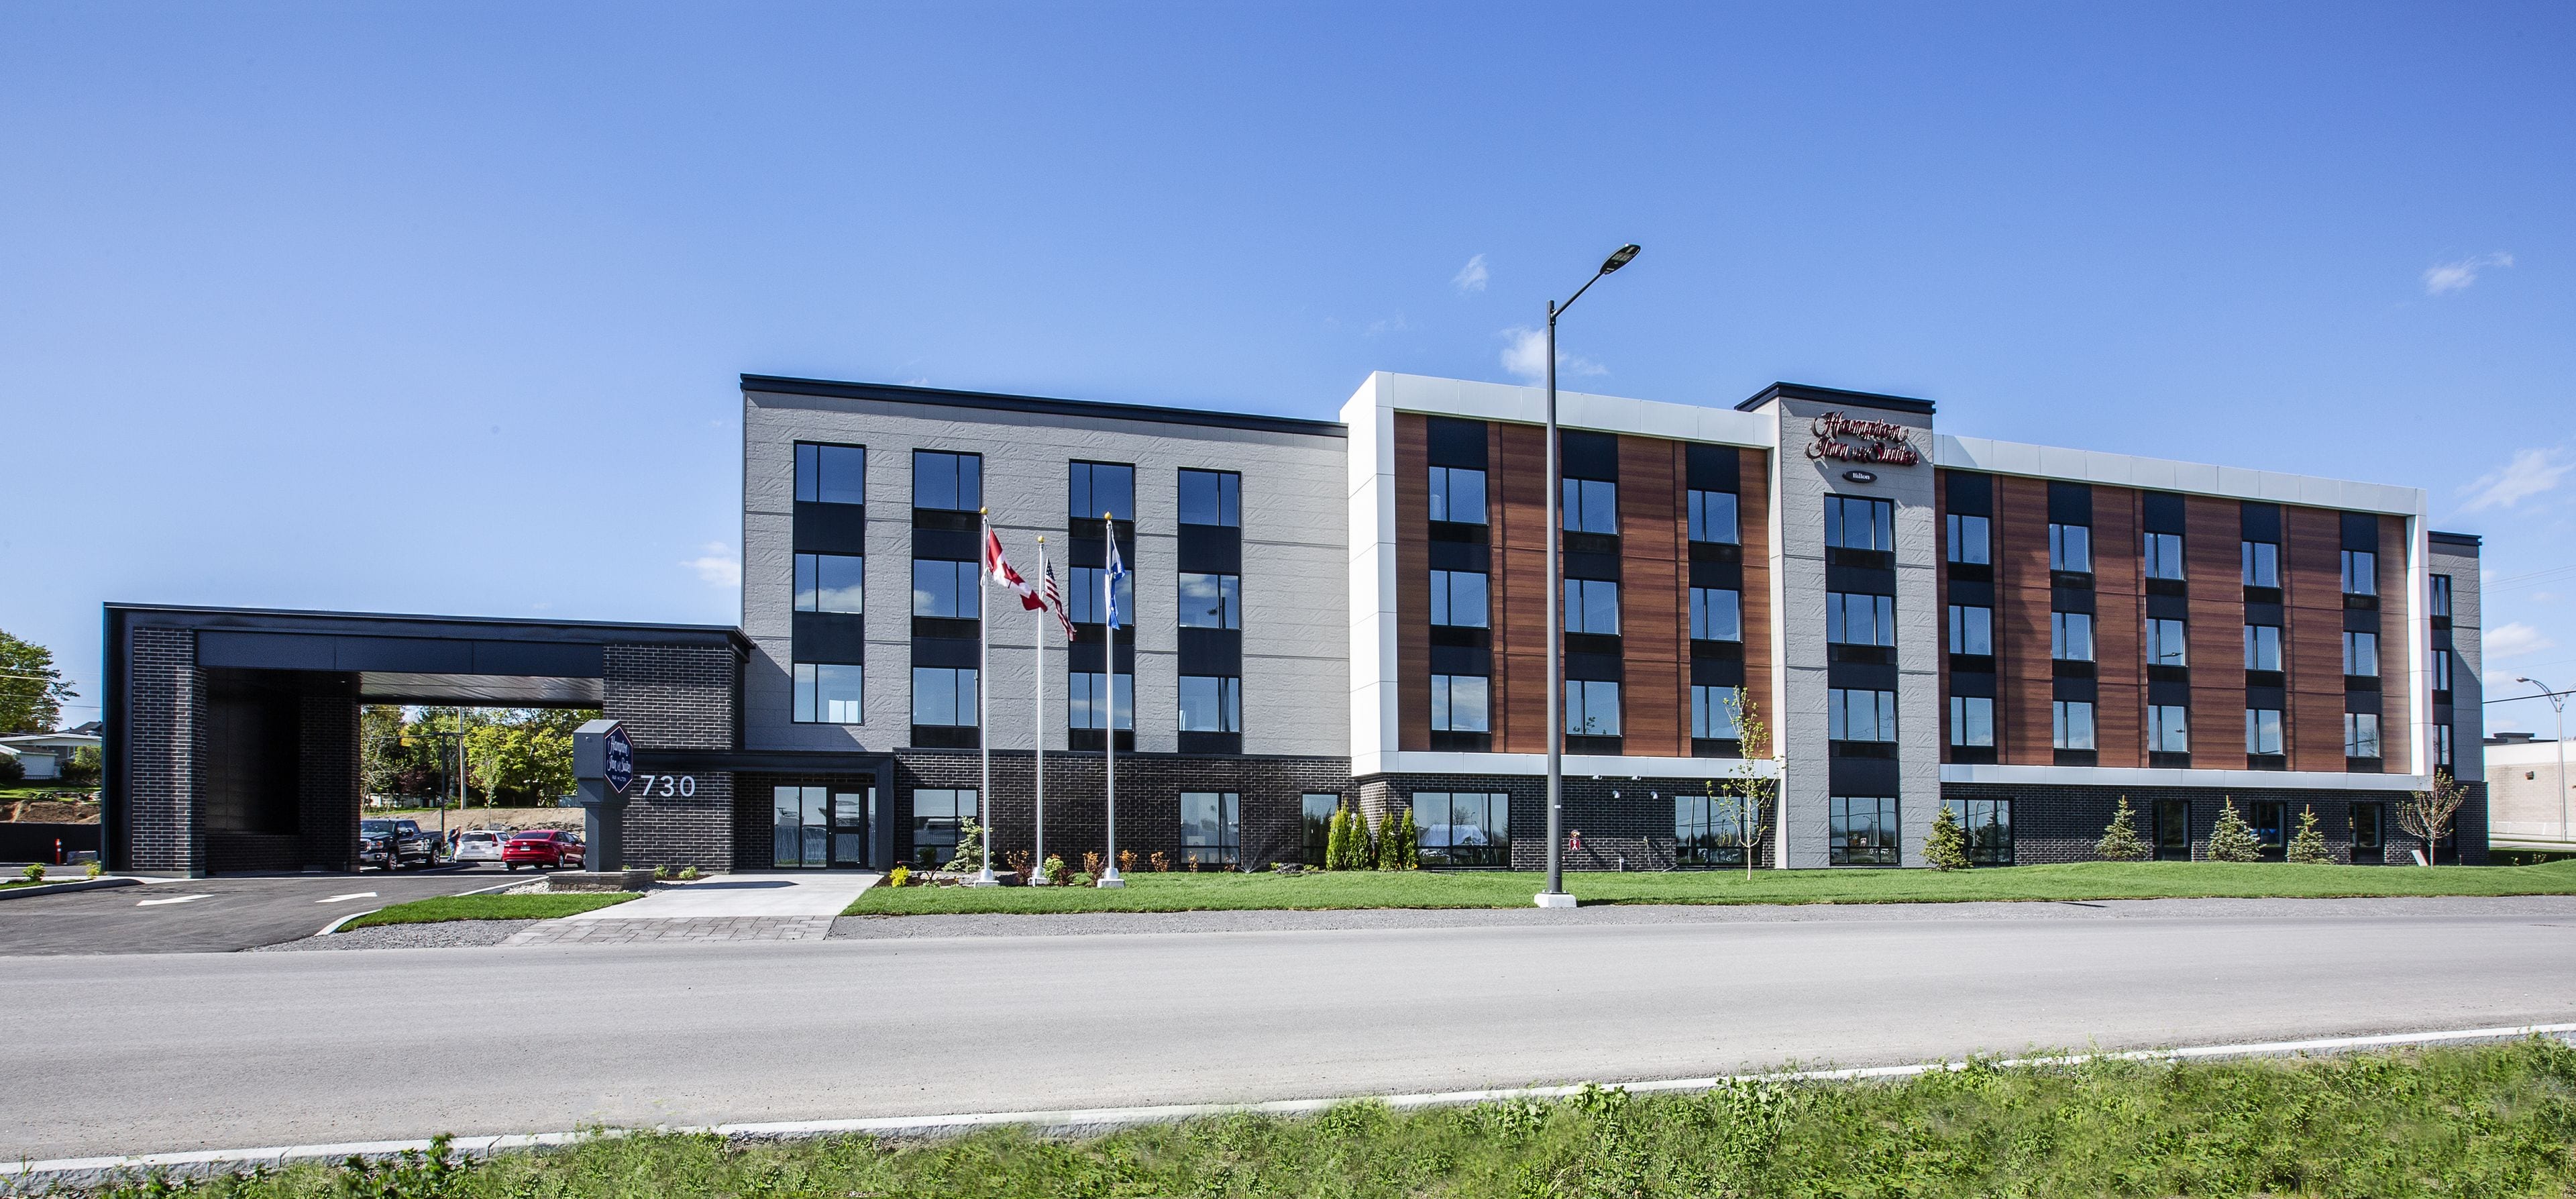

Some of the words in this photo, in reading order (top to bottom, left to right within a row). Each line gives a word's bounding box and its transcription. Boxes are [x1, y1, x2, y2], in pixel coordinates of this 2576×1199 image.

[1811, 411, 1909, 443] Hampton
[1806, 436, 1854, 462] Inn
[1855, 446, 1869, 463] &
[1866, 441, 1919, 466] Suites
[607, 735, 630, 757] Hampton
[641, 775, 696, 797] 730
